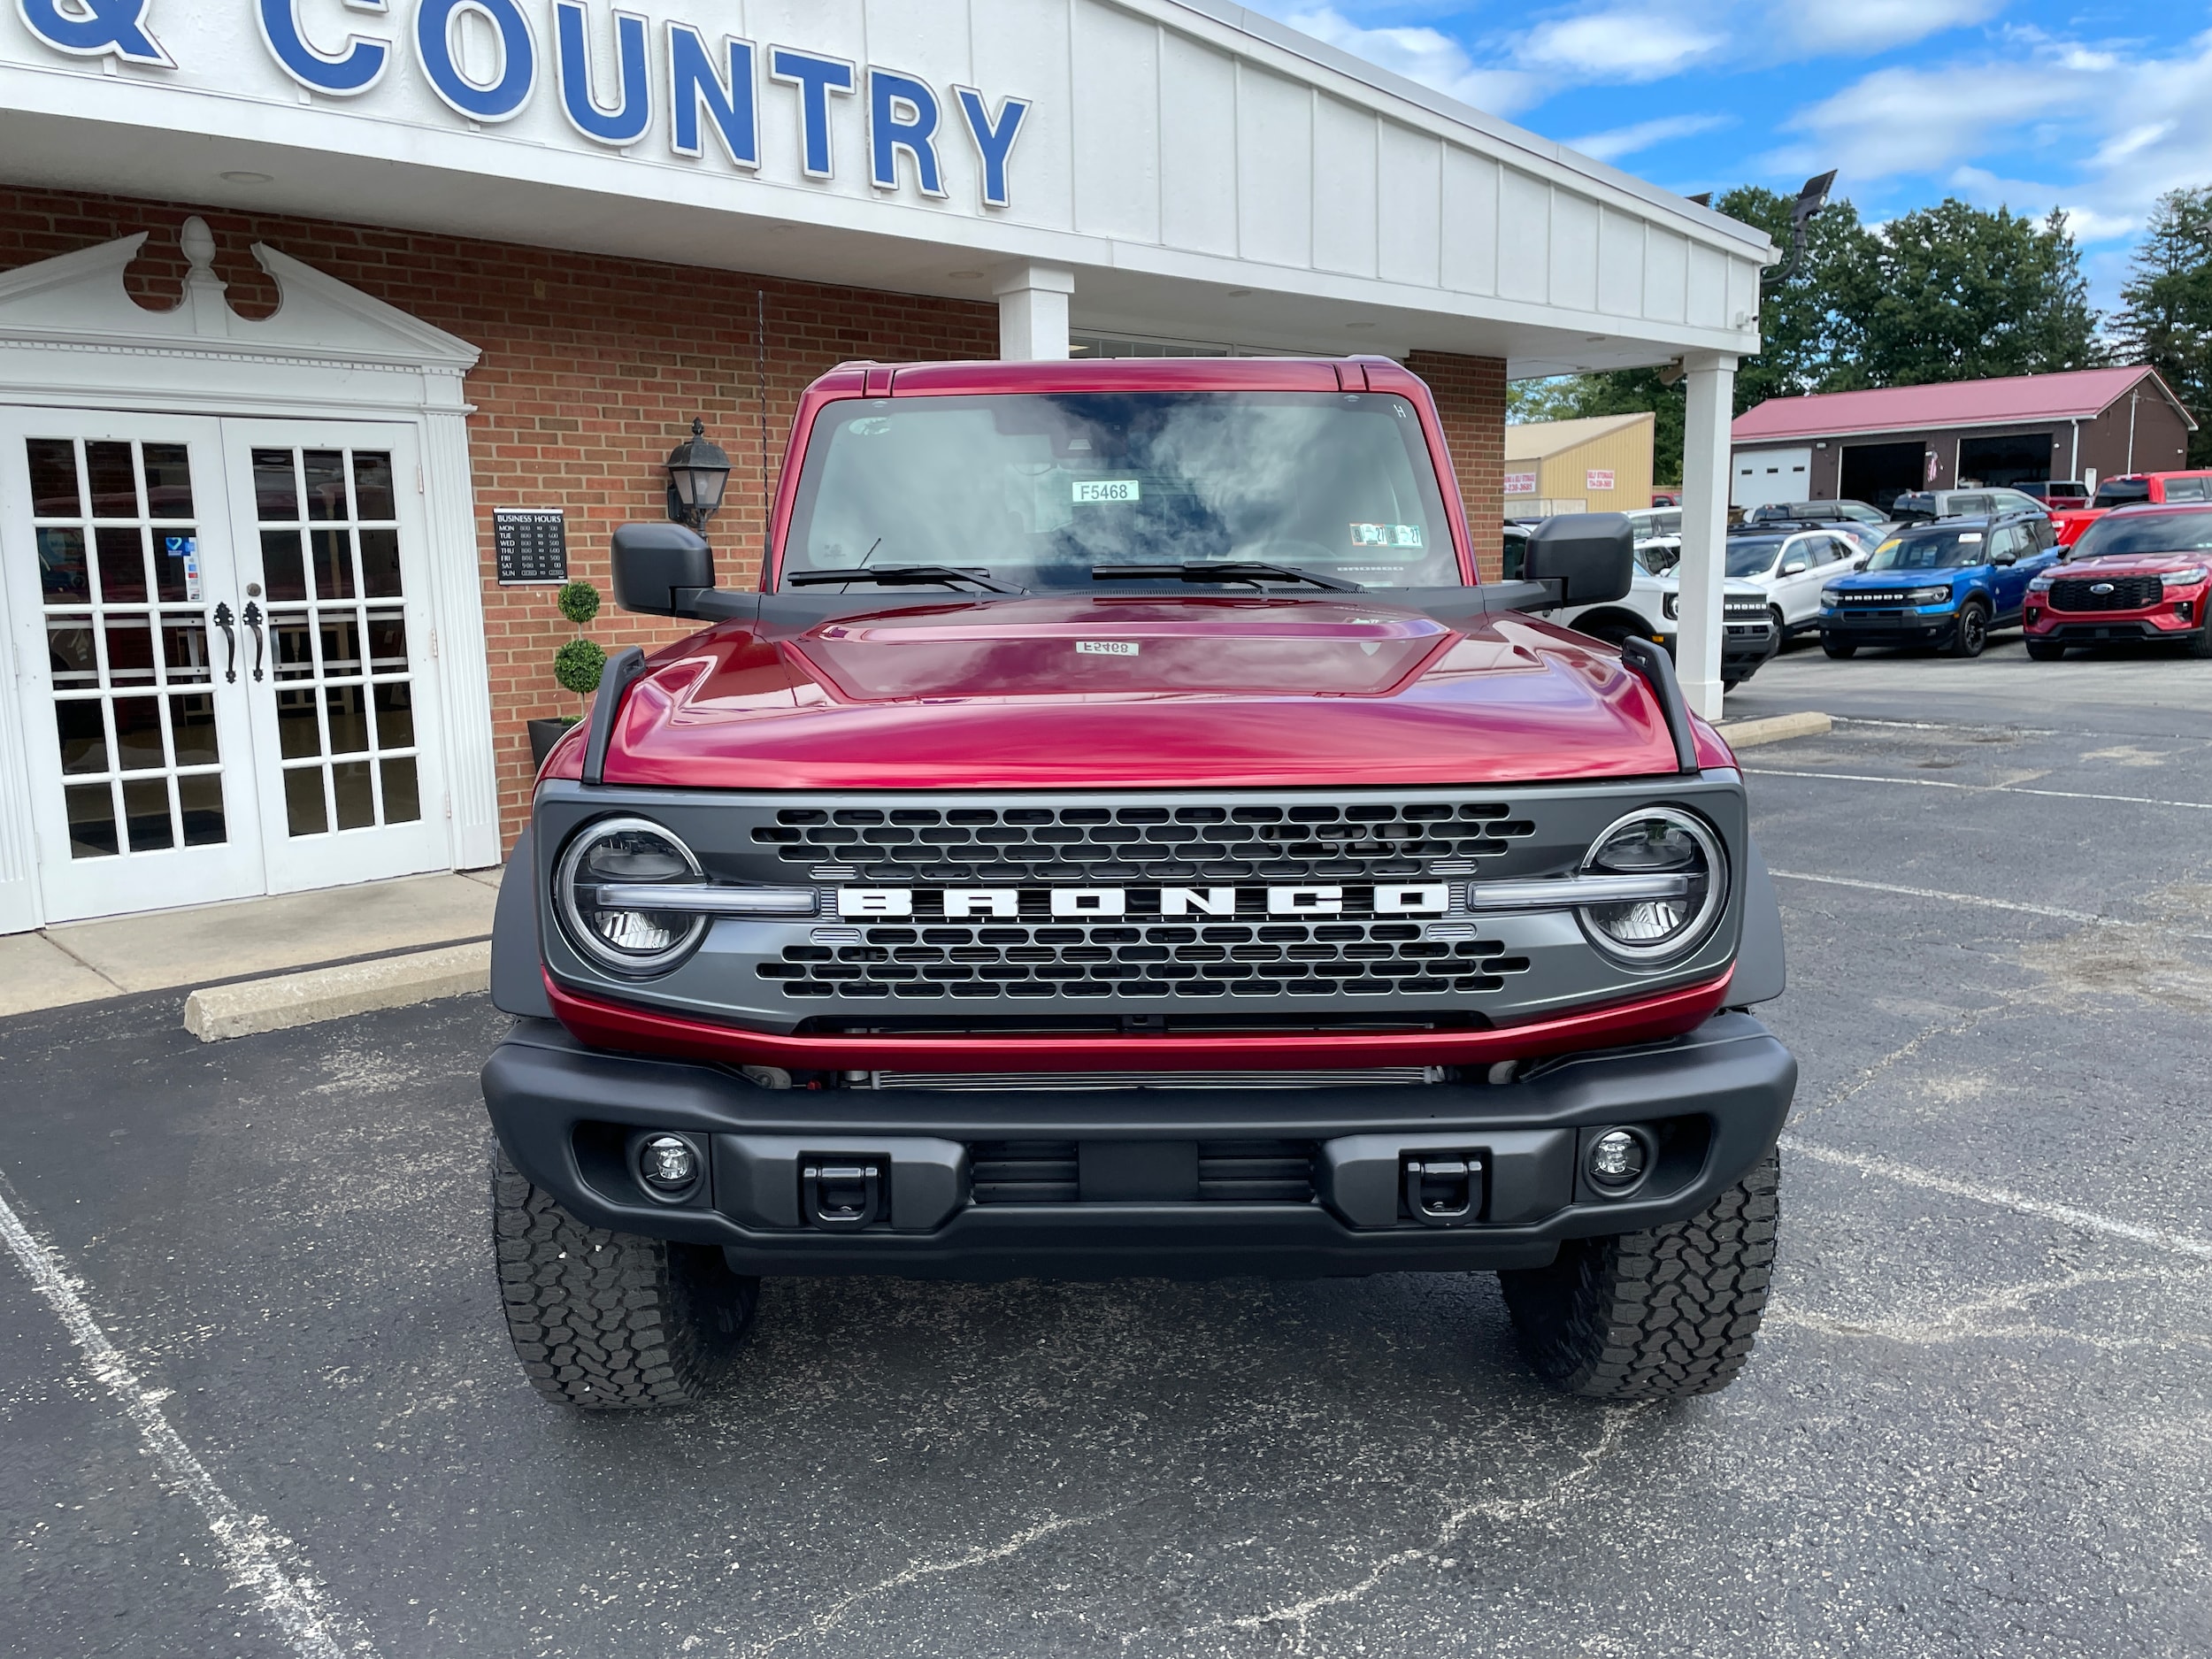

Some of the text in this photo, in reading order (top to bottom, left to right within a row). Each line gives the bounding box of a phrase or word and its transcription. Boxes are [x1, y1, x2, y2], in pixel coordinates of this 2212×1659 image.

[255, 0, 1033, 208] COUNTRY
[1080, 484, 1127, 500] F5468
[1376, 526, 1385, 542] 27
[1410, 528, 1419, 543] 27
[838, 886, 1449, 918] BRONCO
